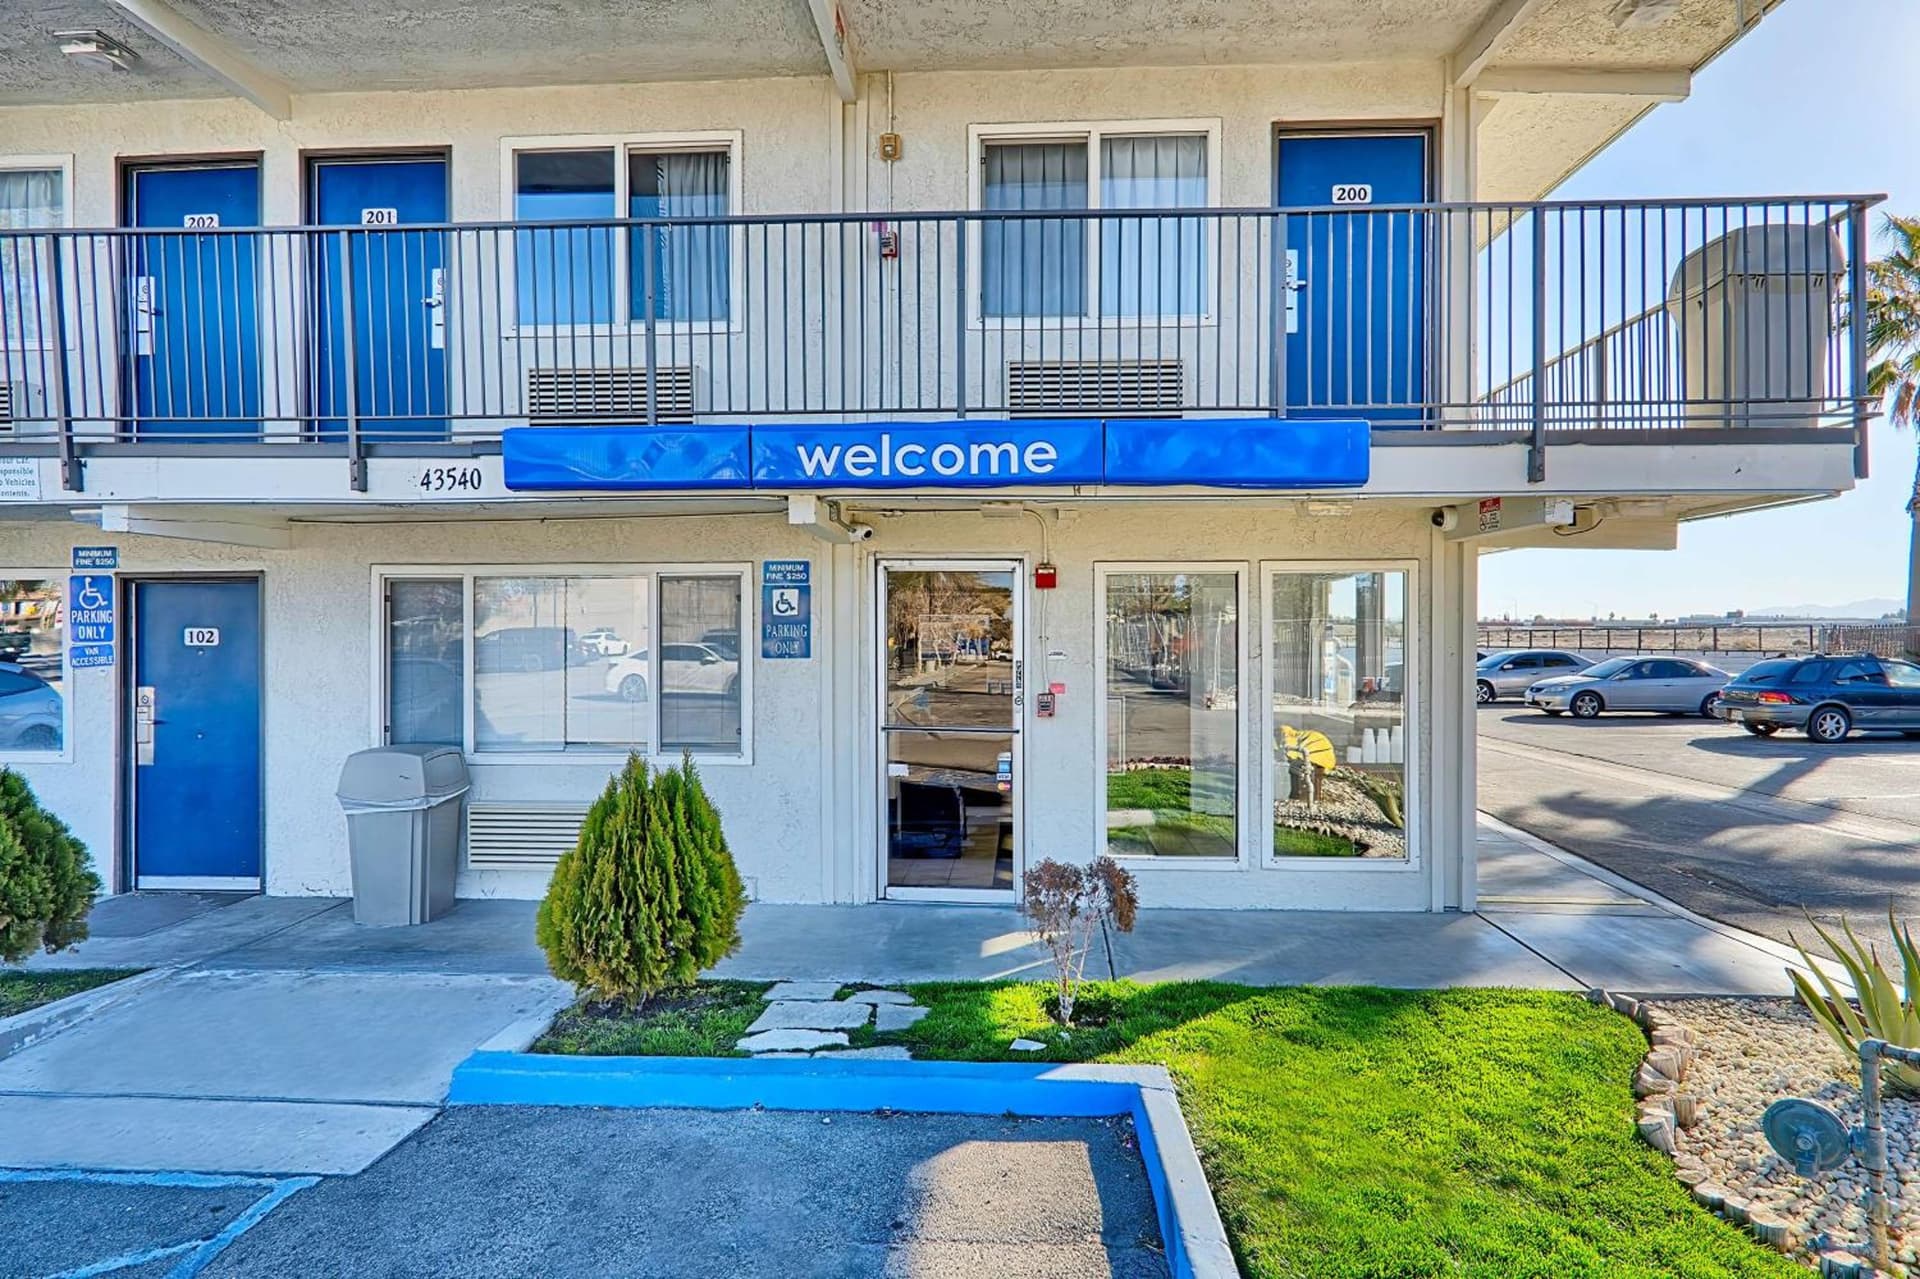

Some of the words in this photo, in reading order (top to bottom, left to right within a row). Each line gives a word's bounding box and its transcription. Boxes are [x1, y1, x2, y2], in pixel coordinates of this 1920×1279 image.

[1336, 186, 1368, 201] 200
[187, 216, 216, 229] 202
[366, 210, 394, 225] 201
[796, 433, 1058, 477] welcome
[420, 466, 482, 492] 43540
[75, 557, 94, 566] FINE
[95, 557, 115, 566] $250
[766, 572, 784, 580] FINE
[786, 571, 807, 580] $250
[71, 610, 113, 624] PARKING
[78, 626, 106, 640] ONLY
[187, 630, 215, 645] 102
[766, 623, 808, 638] PARKING
[84, 646, 99, 656] VAN
[775, 641, 800, 655] ONLY
[71, 655, 113, 666] ACCESSIBLE
